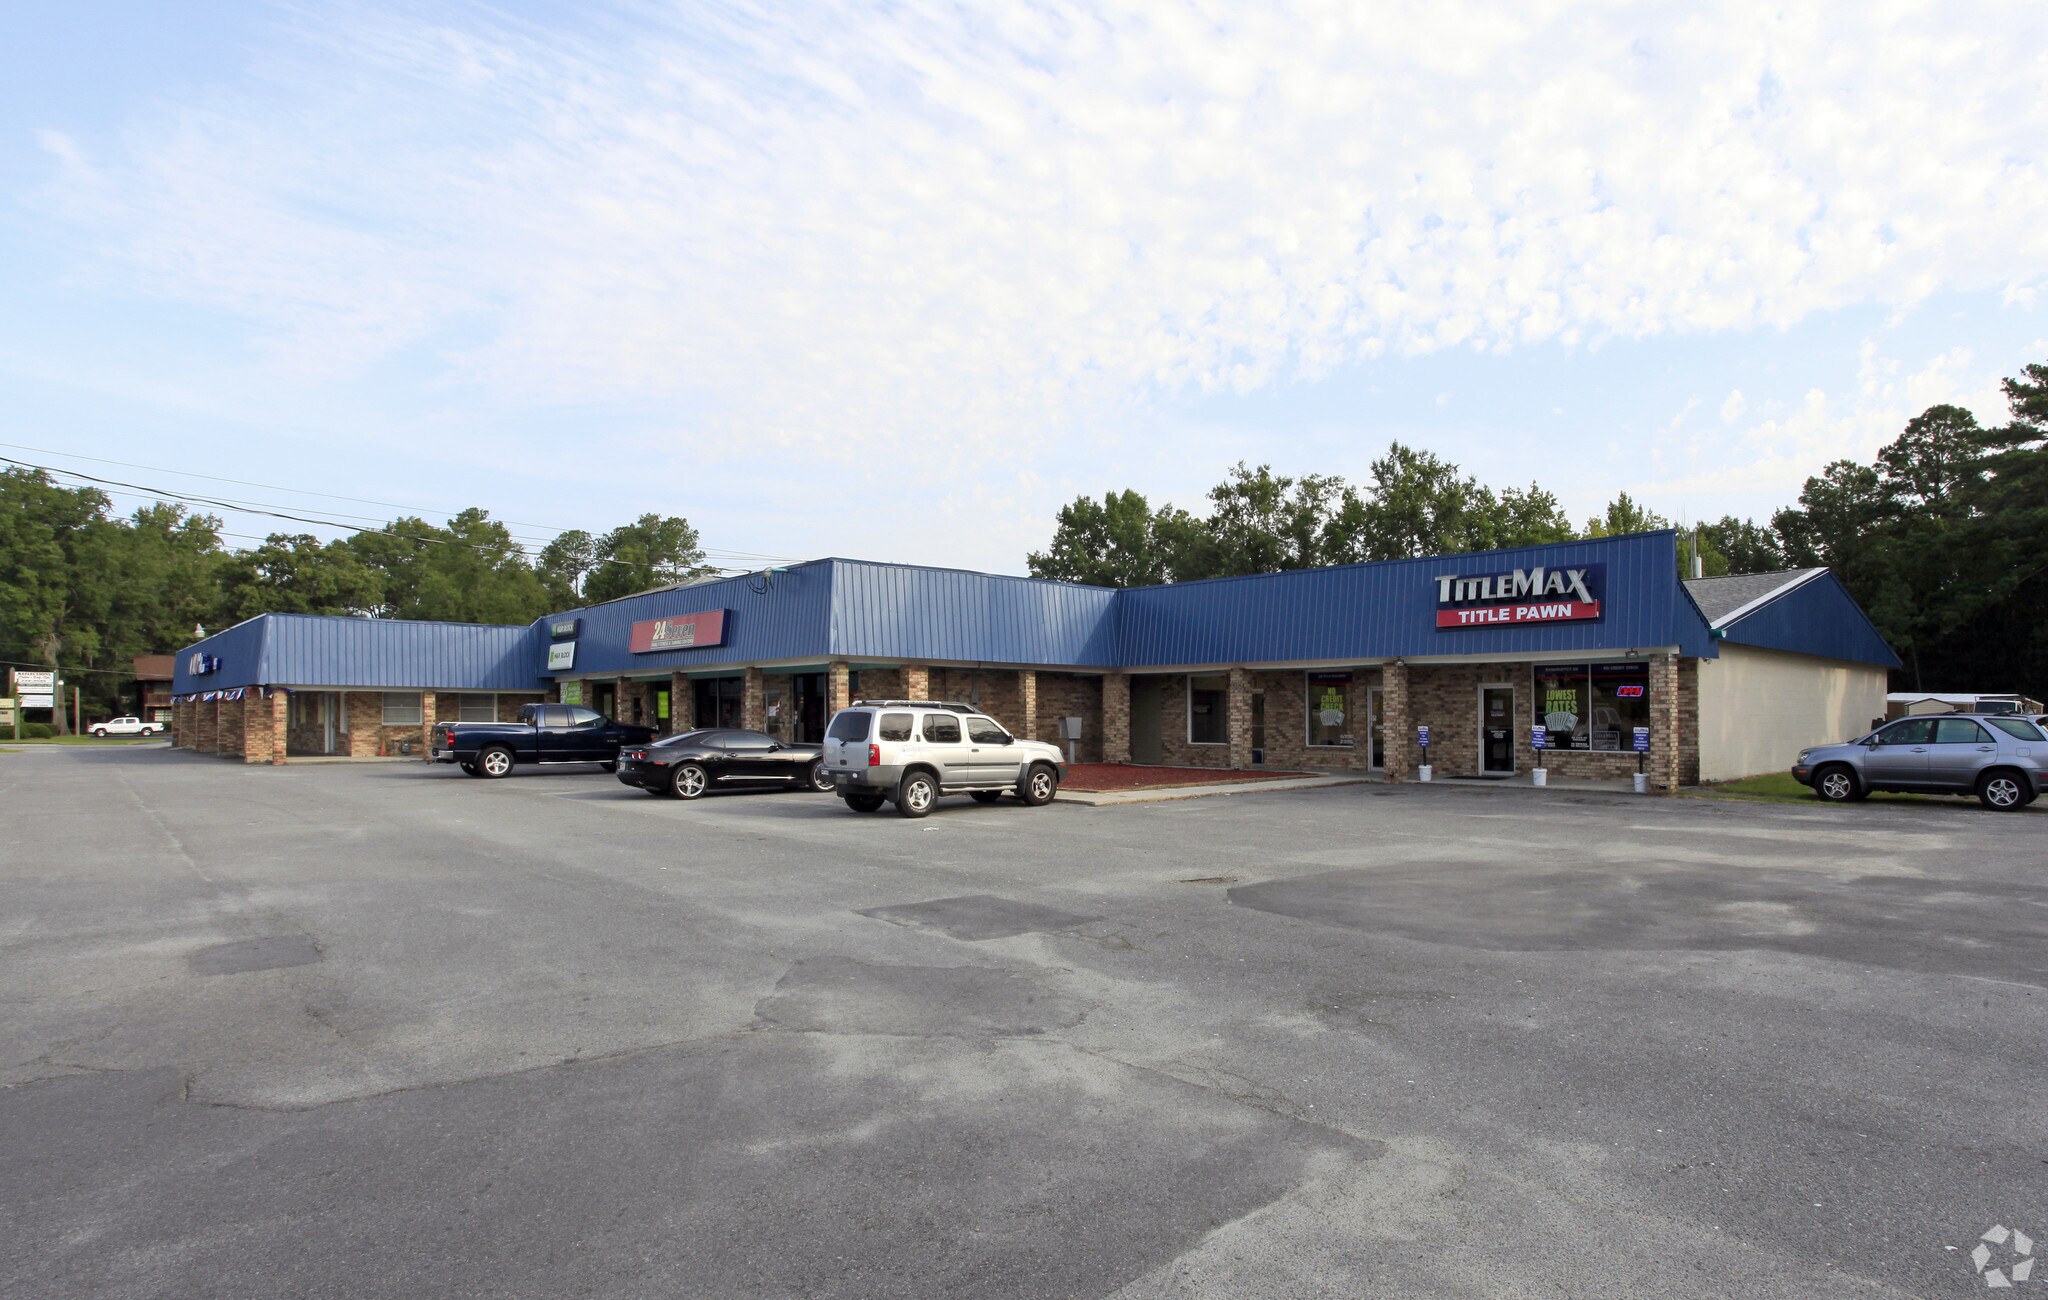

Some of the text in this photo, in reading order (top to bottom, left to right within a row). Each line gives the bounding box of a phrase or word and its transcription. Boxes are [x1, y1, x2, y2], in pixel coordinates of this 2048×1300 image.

[1458, 604, 1572, 624] TITLE PAWN
[1327, 687, 1336, 695] NO
[1546, 689, 1577, 701] LOWEST
[1619, 687, 1642, 696] OPEN
[1321, 695, 1343, 703] CREDIT
[1320, 703, 1344, 712] CHECK
[1545, 700, 1578, 714] RATES
